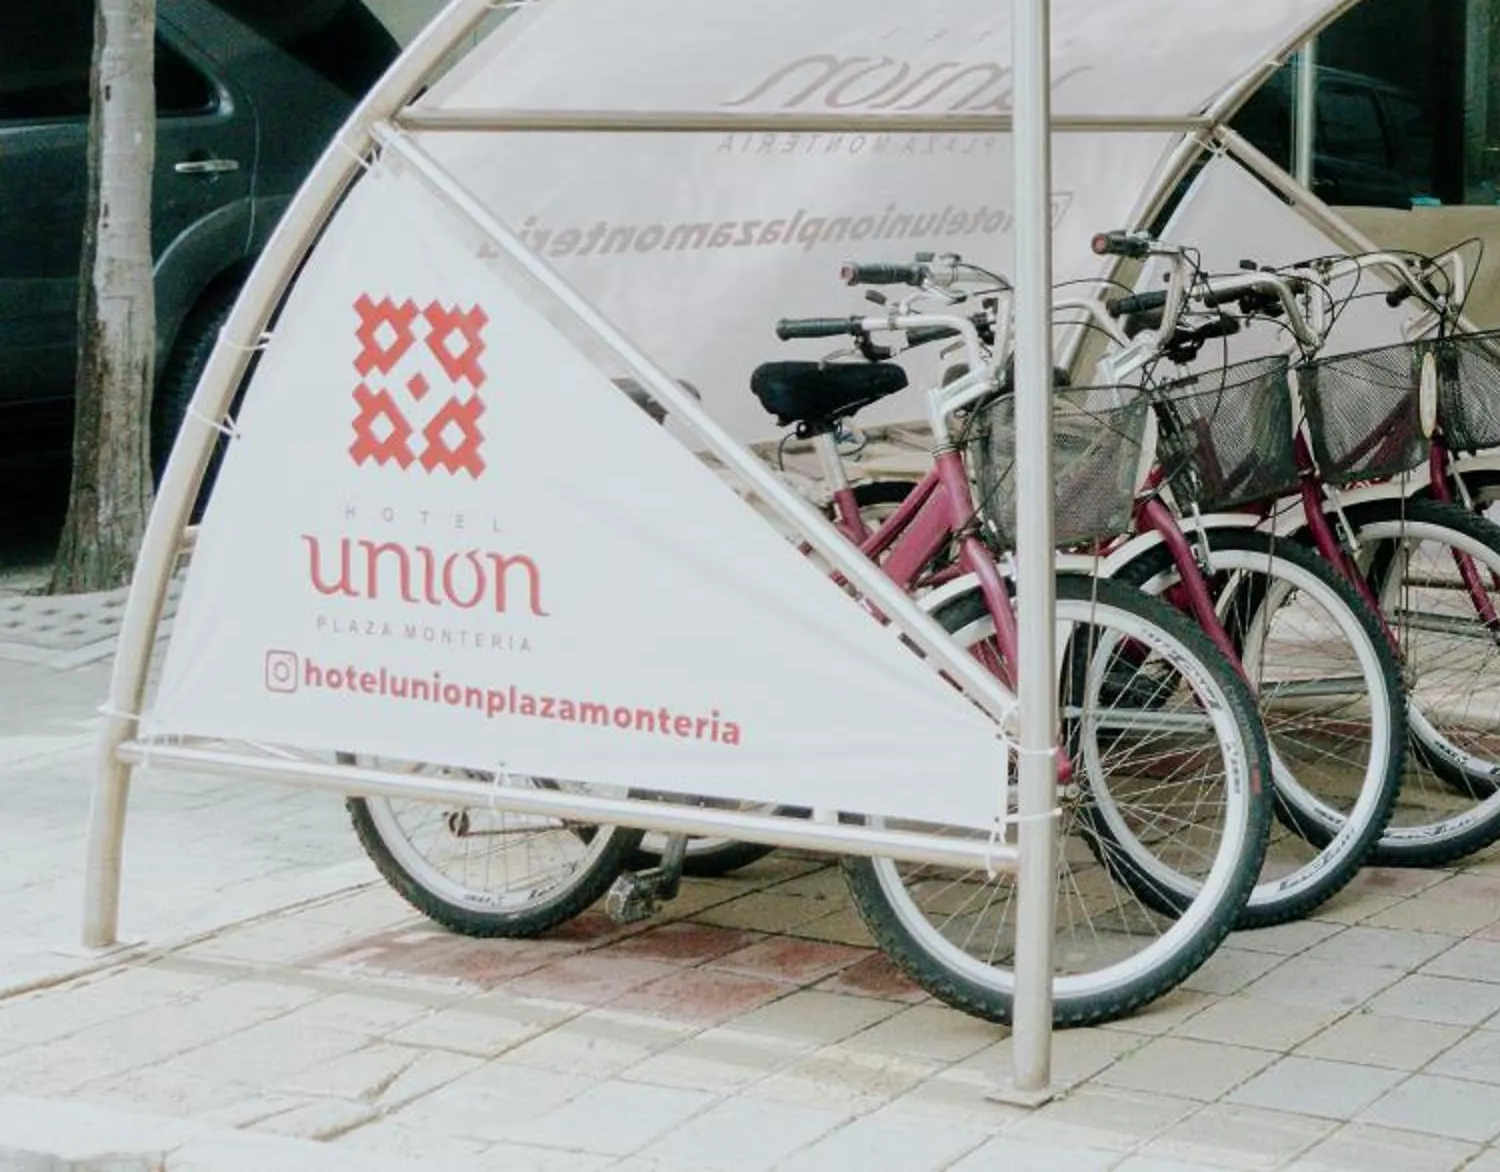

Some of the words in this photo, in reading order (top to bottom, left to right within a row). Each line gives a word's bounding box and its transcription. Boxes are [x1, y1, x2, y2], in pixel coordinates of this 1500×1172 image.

[344, 506, 503, 533] HOTEL
[316, 615, 393, 636] PLAZA
[303, 658, 741, 746] hotelunionplazamonteria
